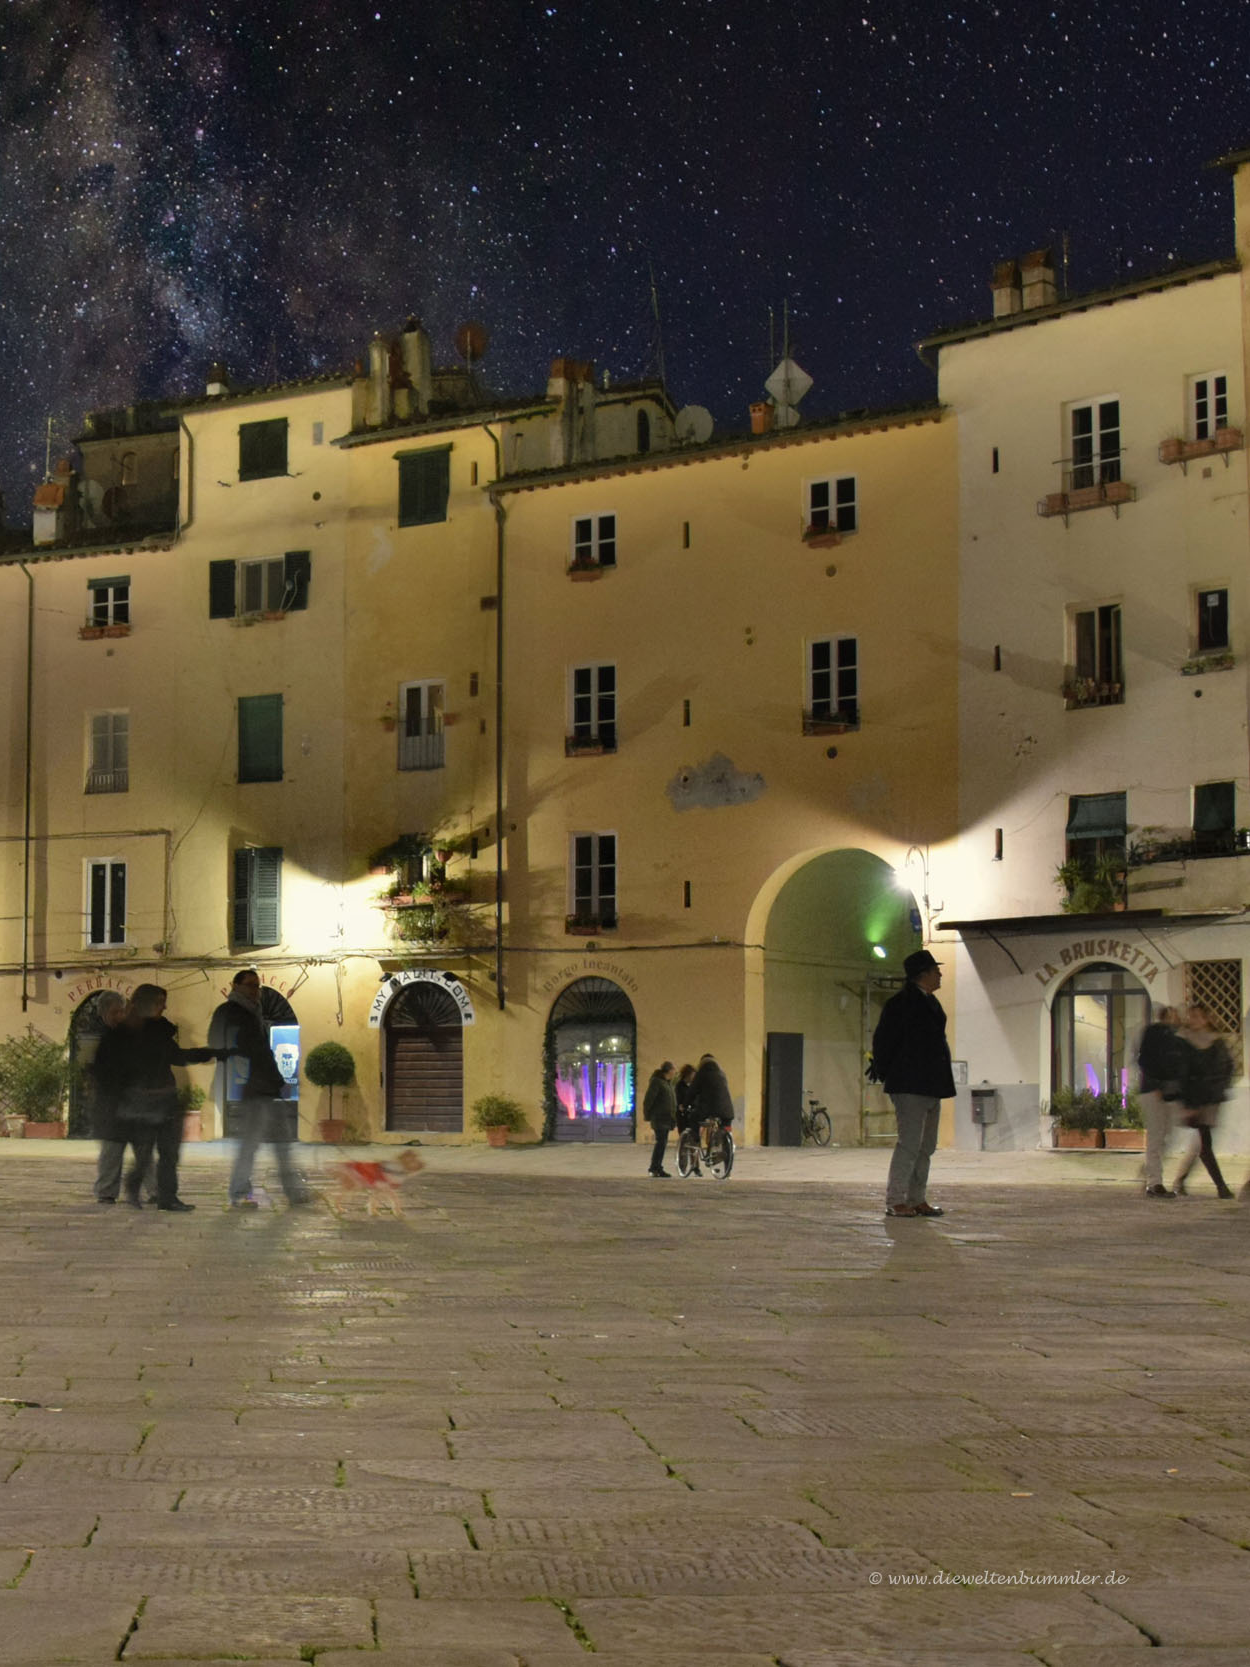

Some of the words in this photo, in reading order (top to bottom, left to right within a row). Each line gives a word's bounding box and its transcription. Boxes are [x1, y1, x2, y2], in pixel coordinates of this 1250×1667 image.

[543, 963, 578, 993] Borgo
[583, 959, 640, 993] Incantato
[1035, 963, 1059, 986] LA
[1060, 939, 1159, 984] BRUSKETTA
[68, 975, 133, 1002] PERBACC
[373, 990, 387, 1011] MY
